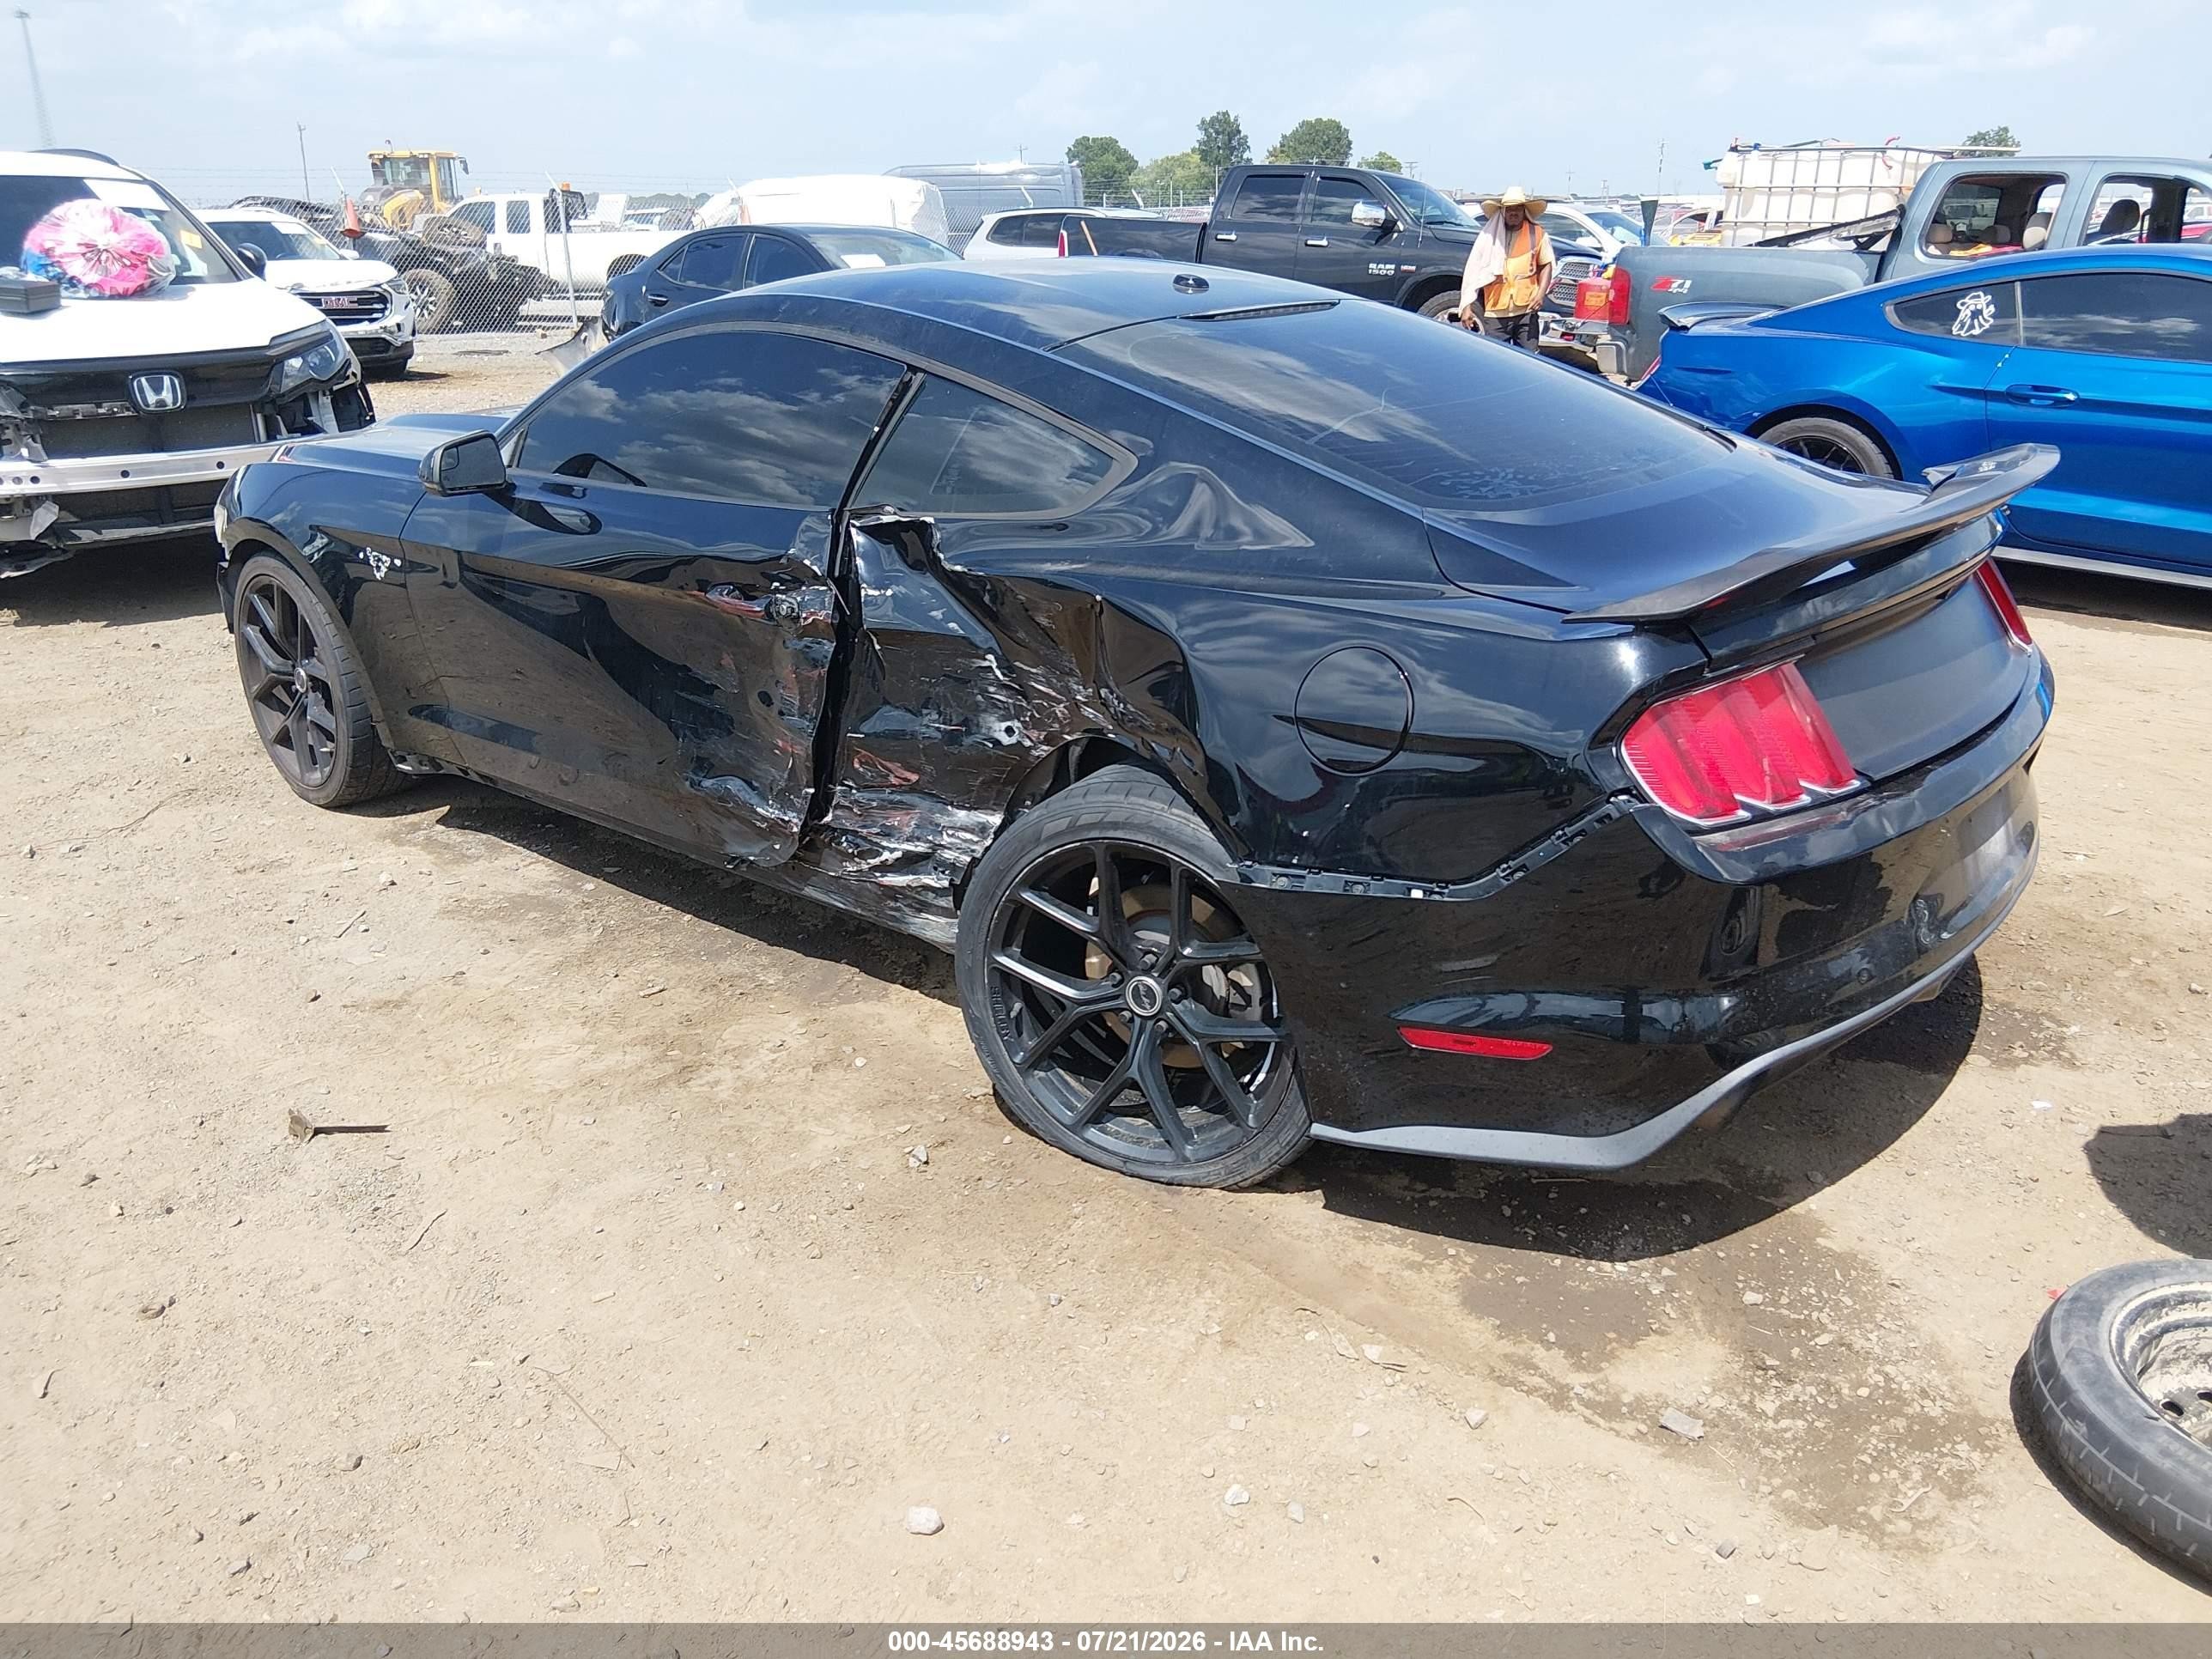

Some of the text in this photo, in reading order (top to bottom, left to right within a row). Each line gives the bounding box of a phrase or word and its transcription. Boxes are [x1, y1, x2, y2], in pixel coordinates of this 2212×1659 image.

[1650, 276, 1692, 290] Z71
[321, 296, 358, 309] GMC
[989, 985, 1012, 1042] SHELBY
